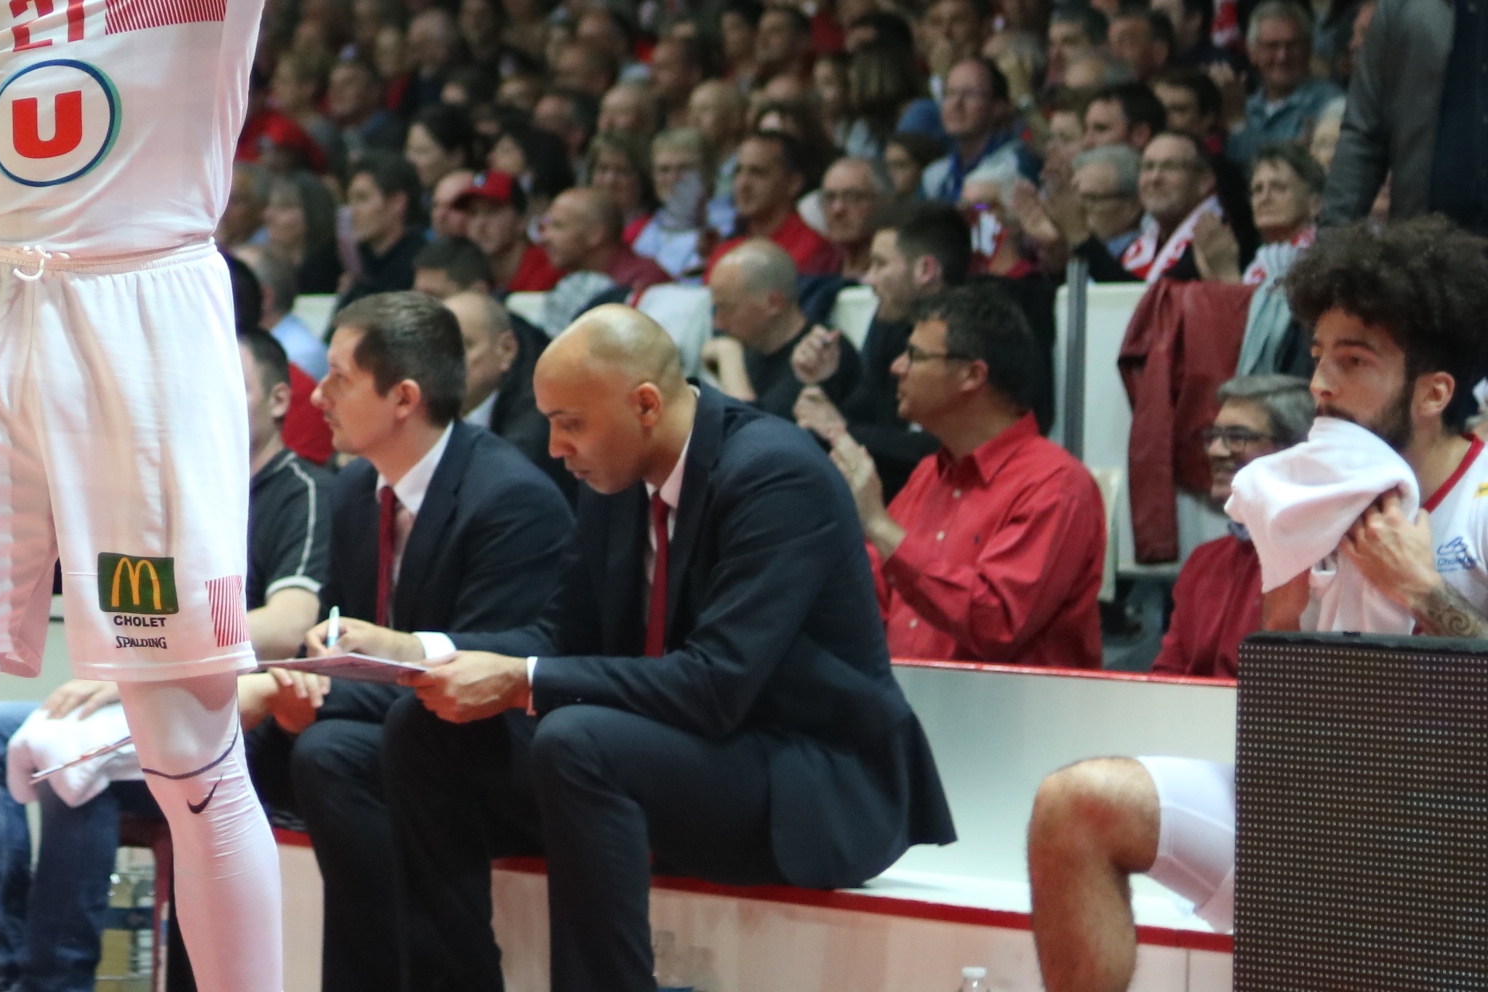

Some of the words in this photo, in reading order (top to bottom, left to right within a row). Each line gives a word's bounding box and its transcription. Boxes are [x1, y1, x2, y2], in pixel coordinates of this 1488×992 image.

[12, 90, 83, 159] U
[113, 615, 167, 628] CHOLET
[115, 635, 168, 650] SPALDING
